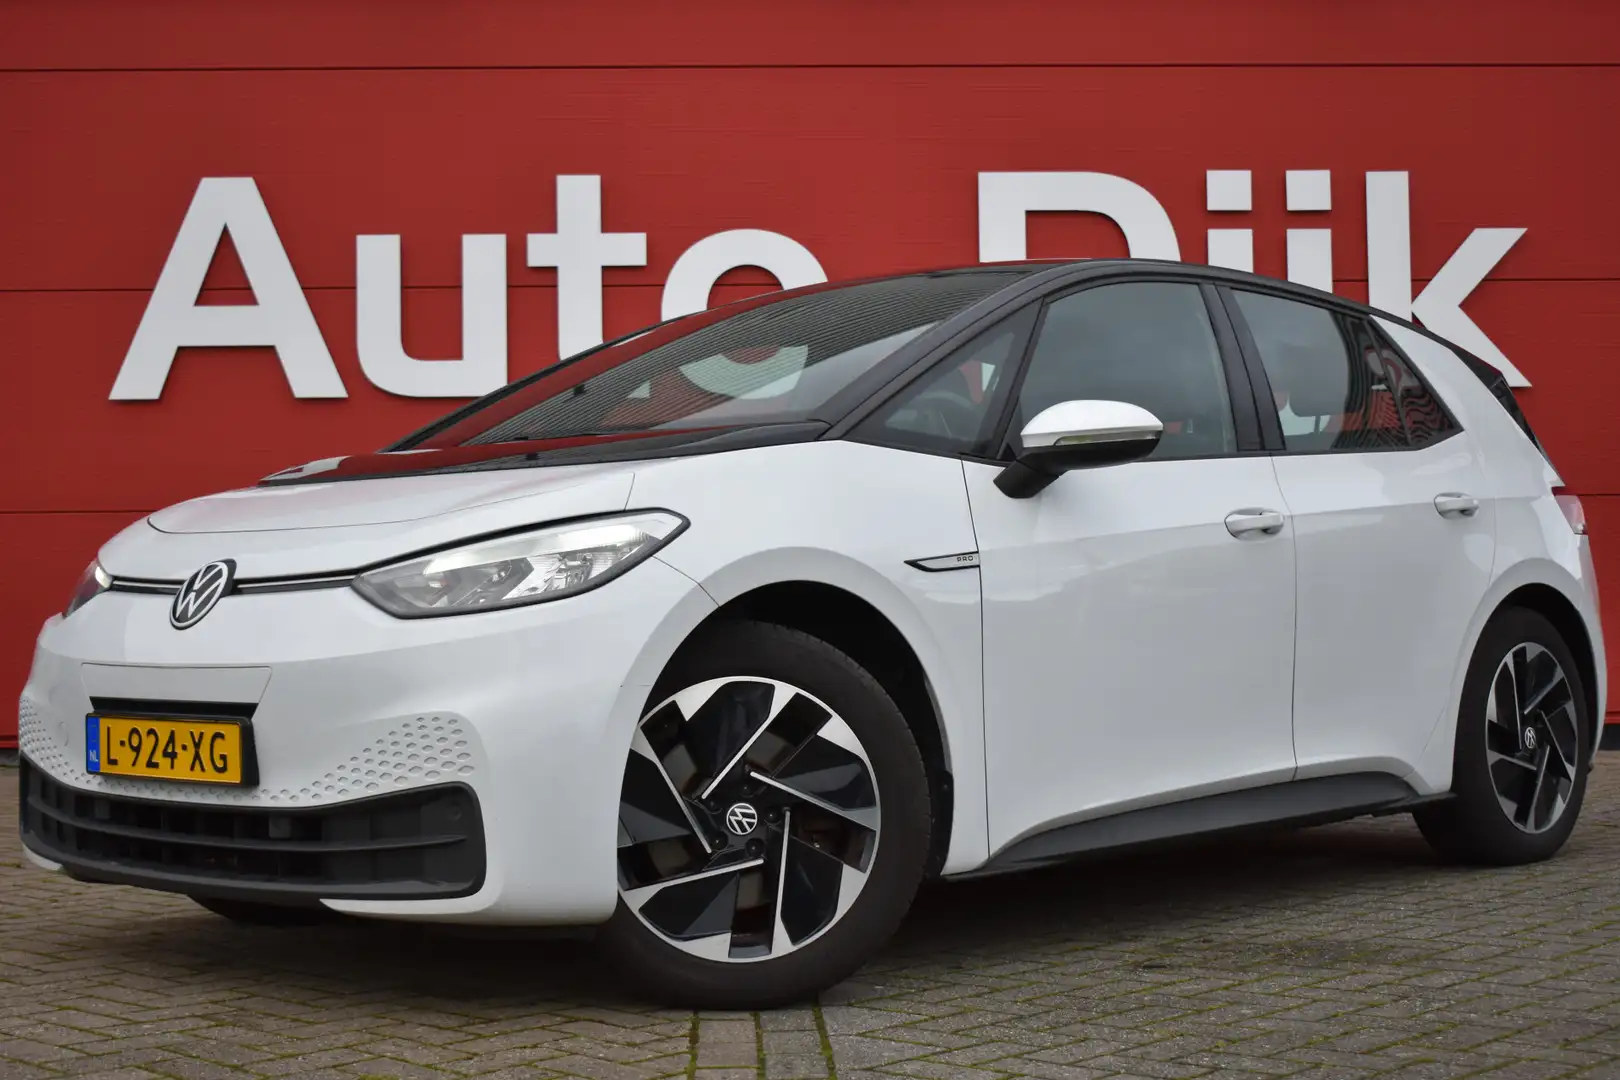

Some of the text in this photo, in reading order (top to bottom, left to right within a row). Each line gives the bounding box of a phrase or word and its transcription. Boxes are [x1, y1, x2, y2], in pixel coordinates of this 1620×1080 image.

[109, 173, 829, 400] Auto
[956, 555, 974, 563] PRO
[89, 749, 99, 762] NL
[106, 725, 229, 774] L-924-XG
